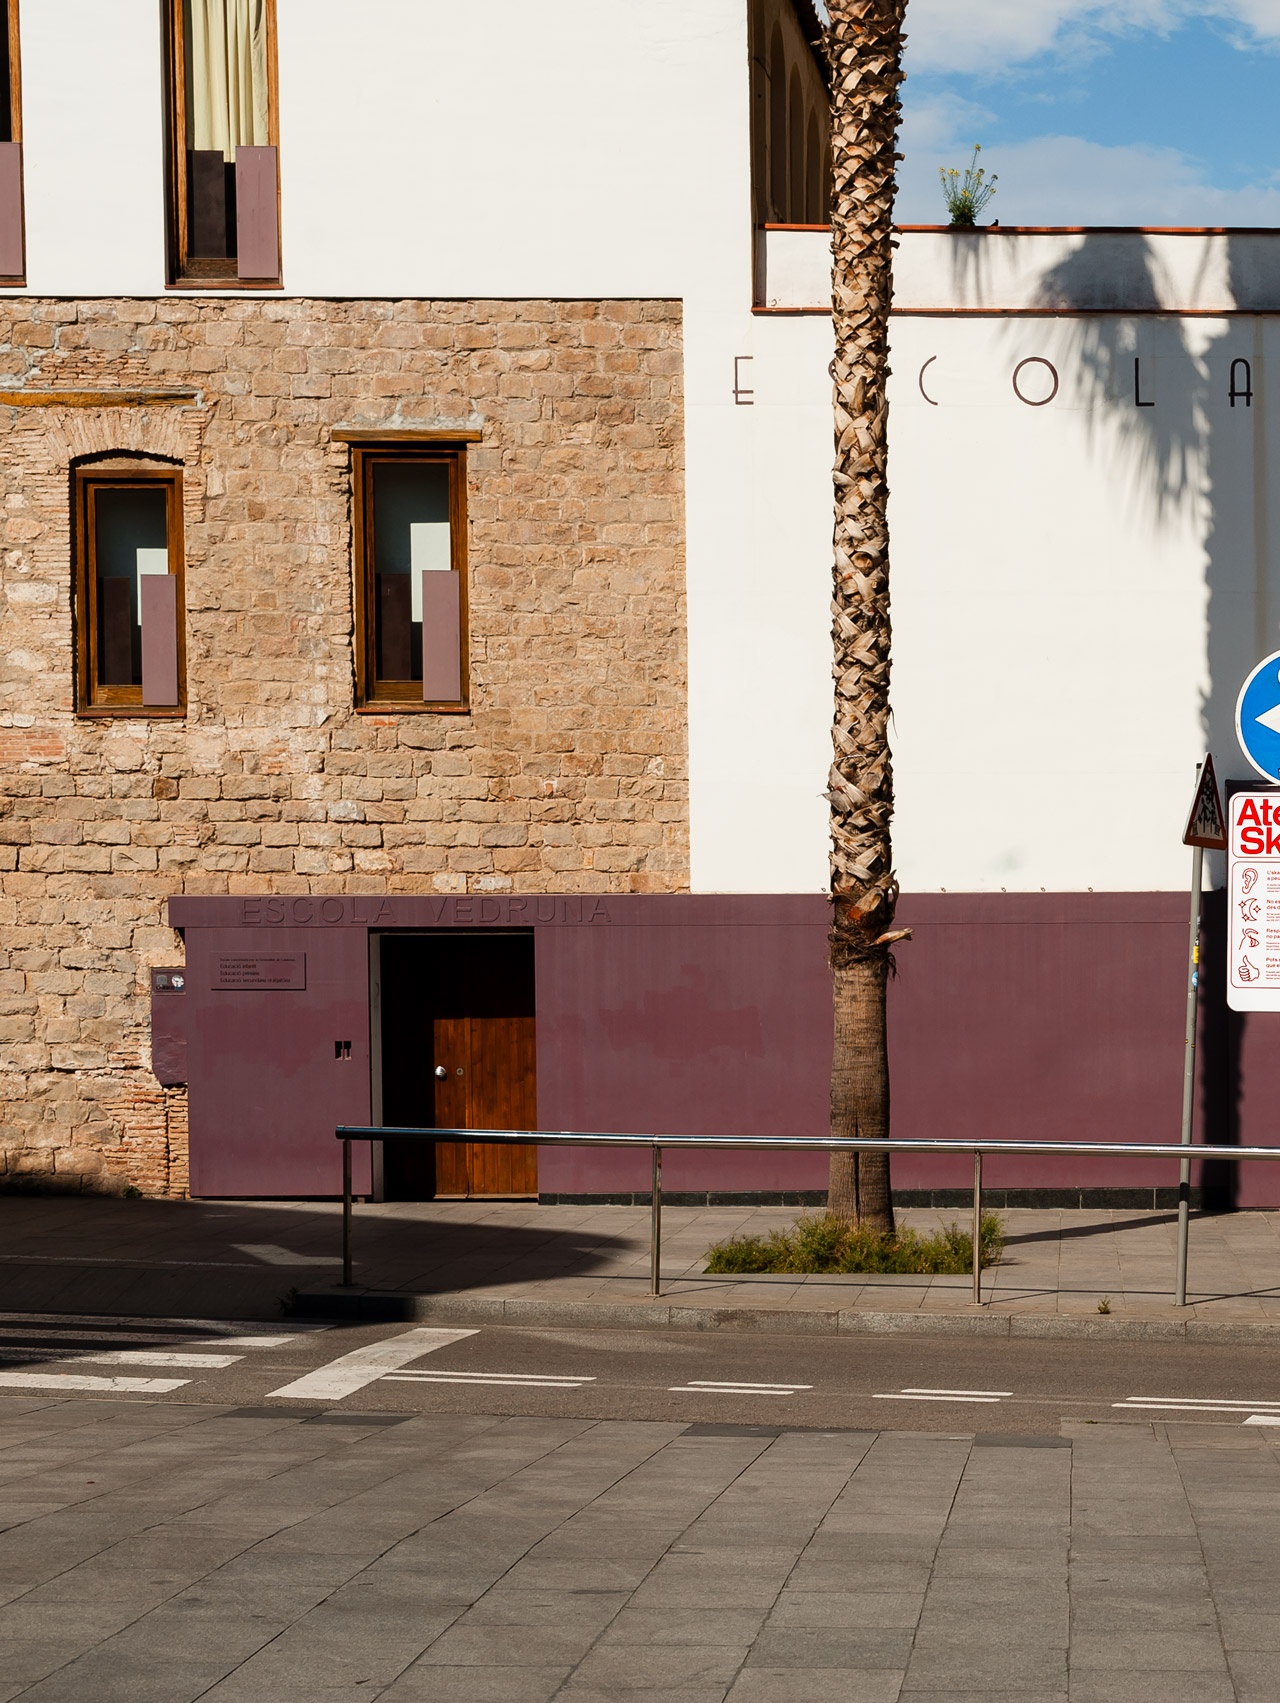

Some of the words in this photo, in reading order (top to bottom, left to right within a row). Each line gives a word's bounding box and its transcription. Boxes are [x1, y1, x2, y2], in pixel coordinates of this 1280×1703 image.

[732, 355, 1254, 407] ECOLA
[240, 897, 397, 924] ESCOLA
[429, 896, 612, 924] VEDRUNA
